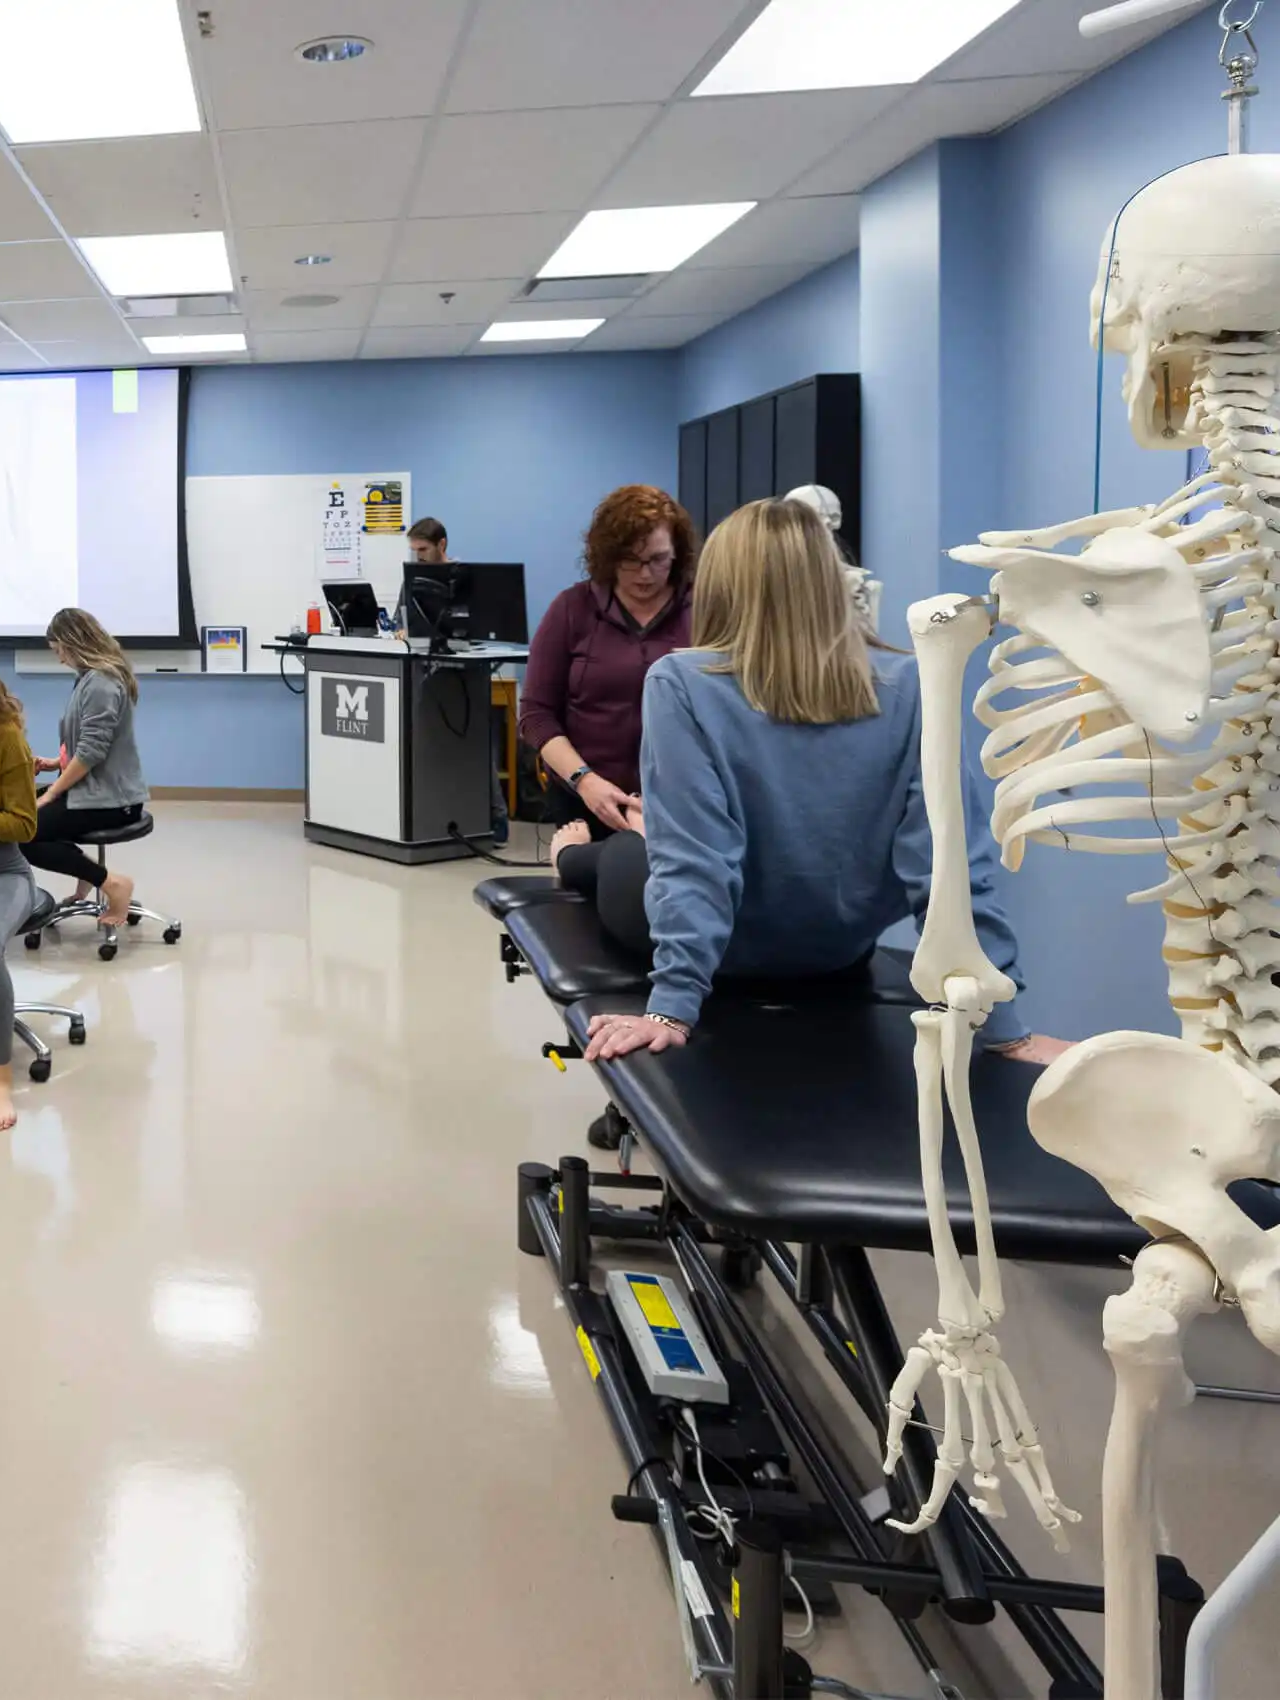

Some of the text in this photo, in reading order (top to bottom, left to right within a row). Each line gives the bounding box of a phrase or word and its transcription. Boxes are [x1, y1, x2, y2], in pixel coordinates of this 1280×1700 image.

[328, 491, 345, 507] E
[340, 510, 349, 519] P
[335, 684, 369, 721] M
[336, 719, 369, 735] FLINT
